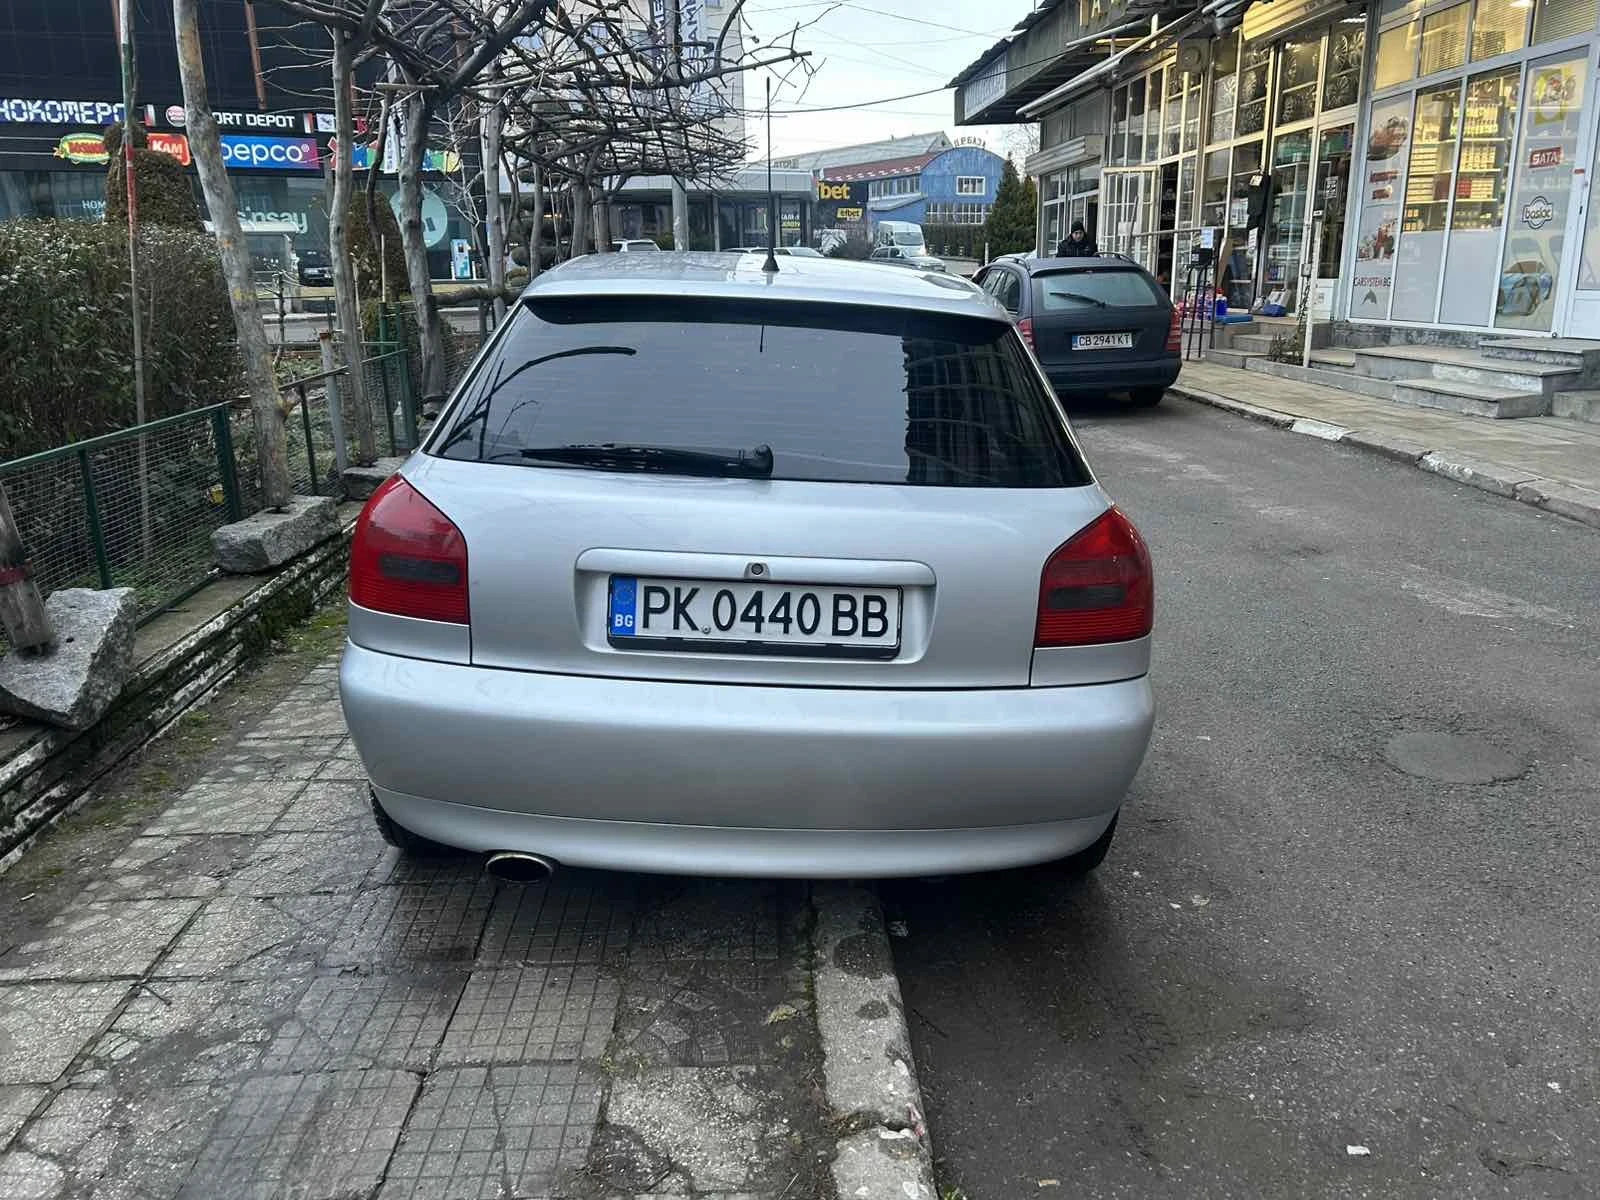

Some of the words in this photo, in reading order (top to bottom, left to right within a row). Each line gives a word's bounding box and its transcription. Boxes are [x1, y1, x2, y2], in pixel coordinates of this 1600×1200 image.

[246, 113, 295, 128] DEPOT
[1532, 151, 1558, 165] SATA
[1079, 336, 1091, 346] CB
[1093, 335, 1116, 346] 2941
[1117, 334, 1130, 345] KT
[642, 585, 700, 631] PK
[712, 589, 821, 635] 0440
[831, 593, 888, 637] BB
[614, 614, 633, 628] BG
